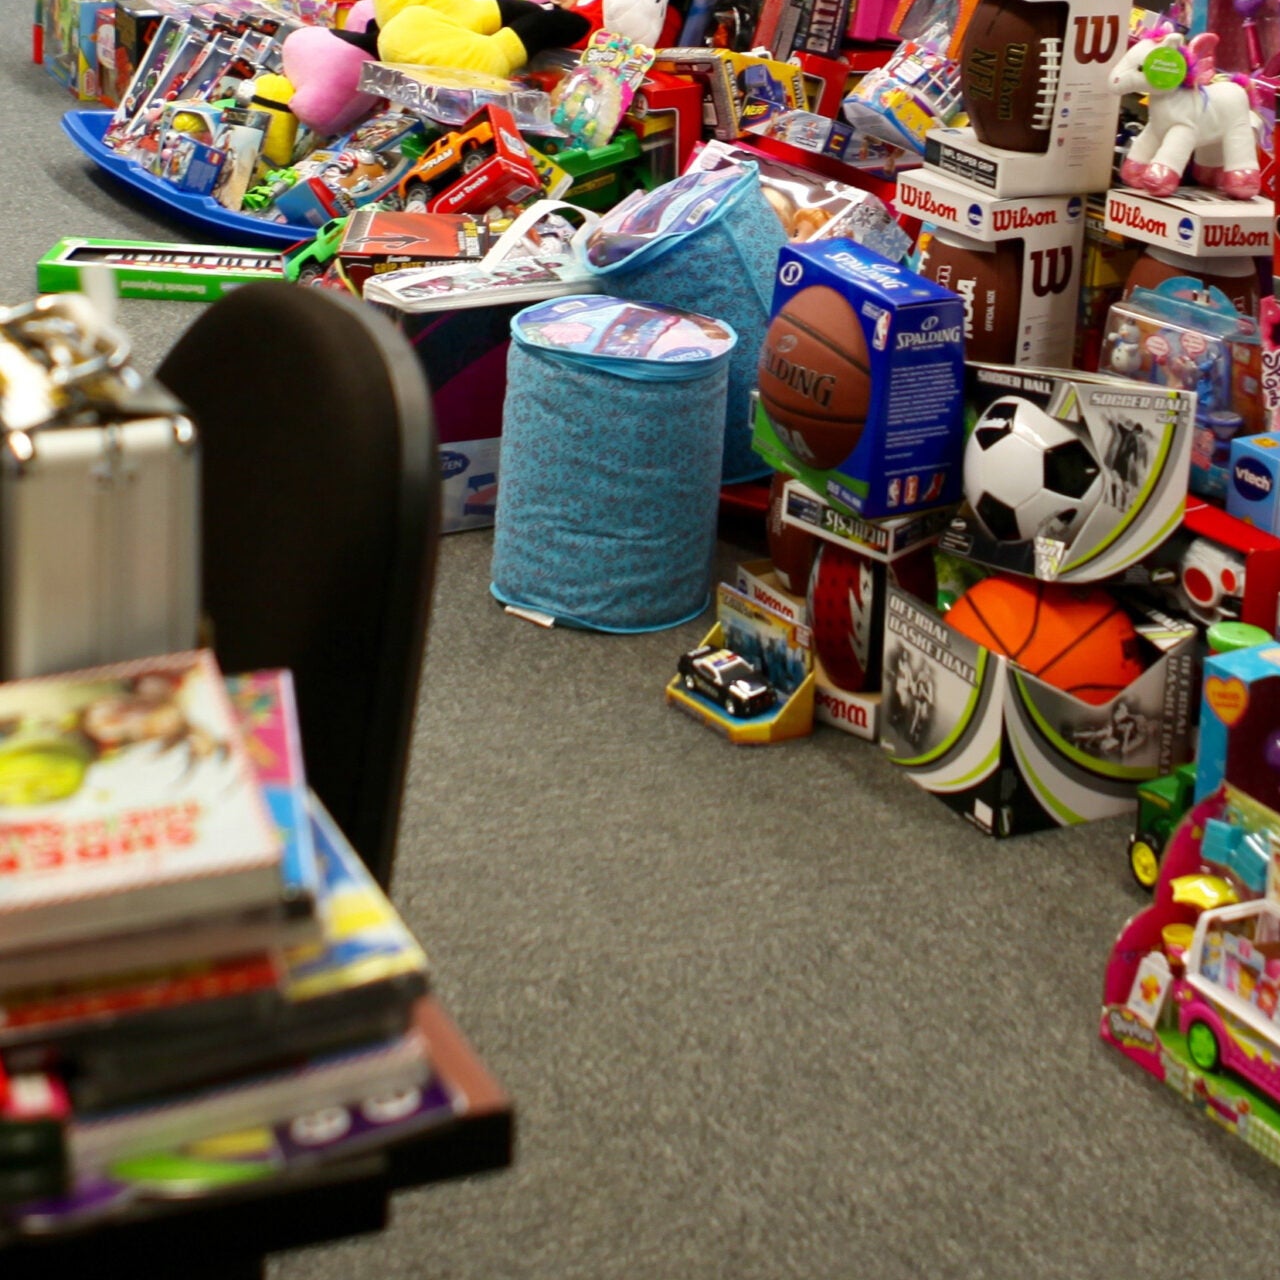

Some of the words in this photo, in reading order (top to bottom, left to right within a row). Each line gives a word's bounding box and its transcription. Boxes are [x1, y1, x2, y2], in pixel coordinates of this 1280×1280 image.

[1073, 14, 1120, 65] W
[969, 47, 999, 101] NFL
[999, 42, 1029, 120] Wilson
[742, 103, 769, 117] NERF
[955, 150, 978, 168] SUPER
[978, 157, 995, 173] GRIP
[449, 192, 465, 206] Fast
[464, 174, 489, 194] Trucks
[900, 183, 958, 222] Wilson
[992, 206, 1058, 232] Wilson
[1109, 199, 1169, 238] Wilson
[1203, 224, 1270, 248] Wilson
[825, 251, 908, 290] SPALDING
[1030, 245, 1073, 298] W
[896, 325, 961, 350] SPALDING
[977, 369, 1020, 393] SOCCER
[1020, 376, 1051, 395] BALL
[1262, 376, 1280, 410] Girls
[1090, 391, 1151, 410] SOCCER
[1153, 398, 1192, 412] BALL
[1234, 465, 1272, 494] vtech
[825, 508, 890, 548] nemesis
[889, 593, 952, 646] OFFICIAL
[888, 614, 978, 688] BASKETBALL
[815, 694, 868, 729] Wilso
